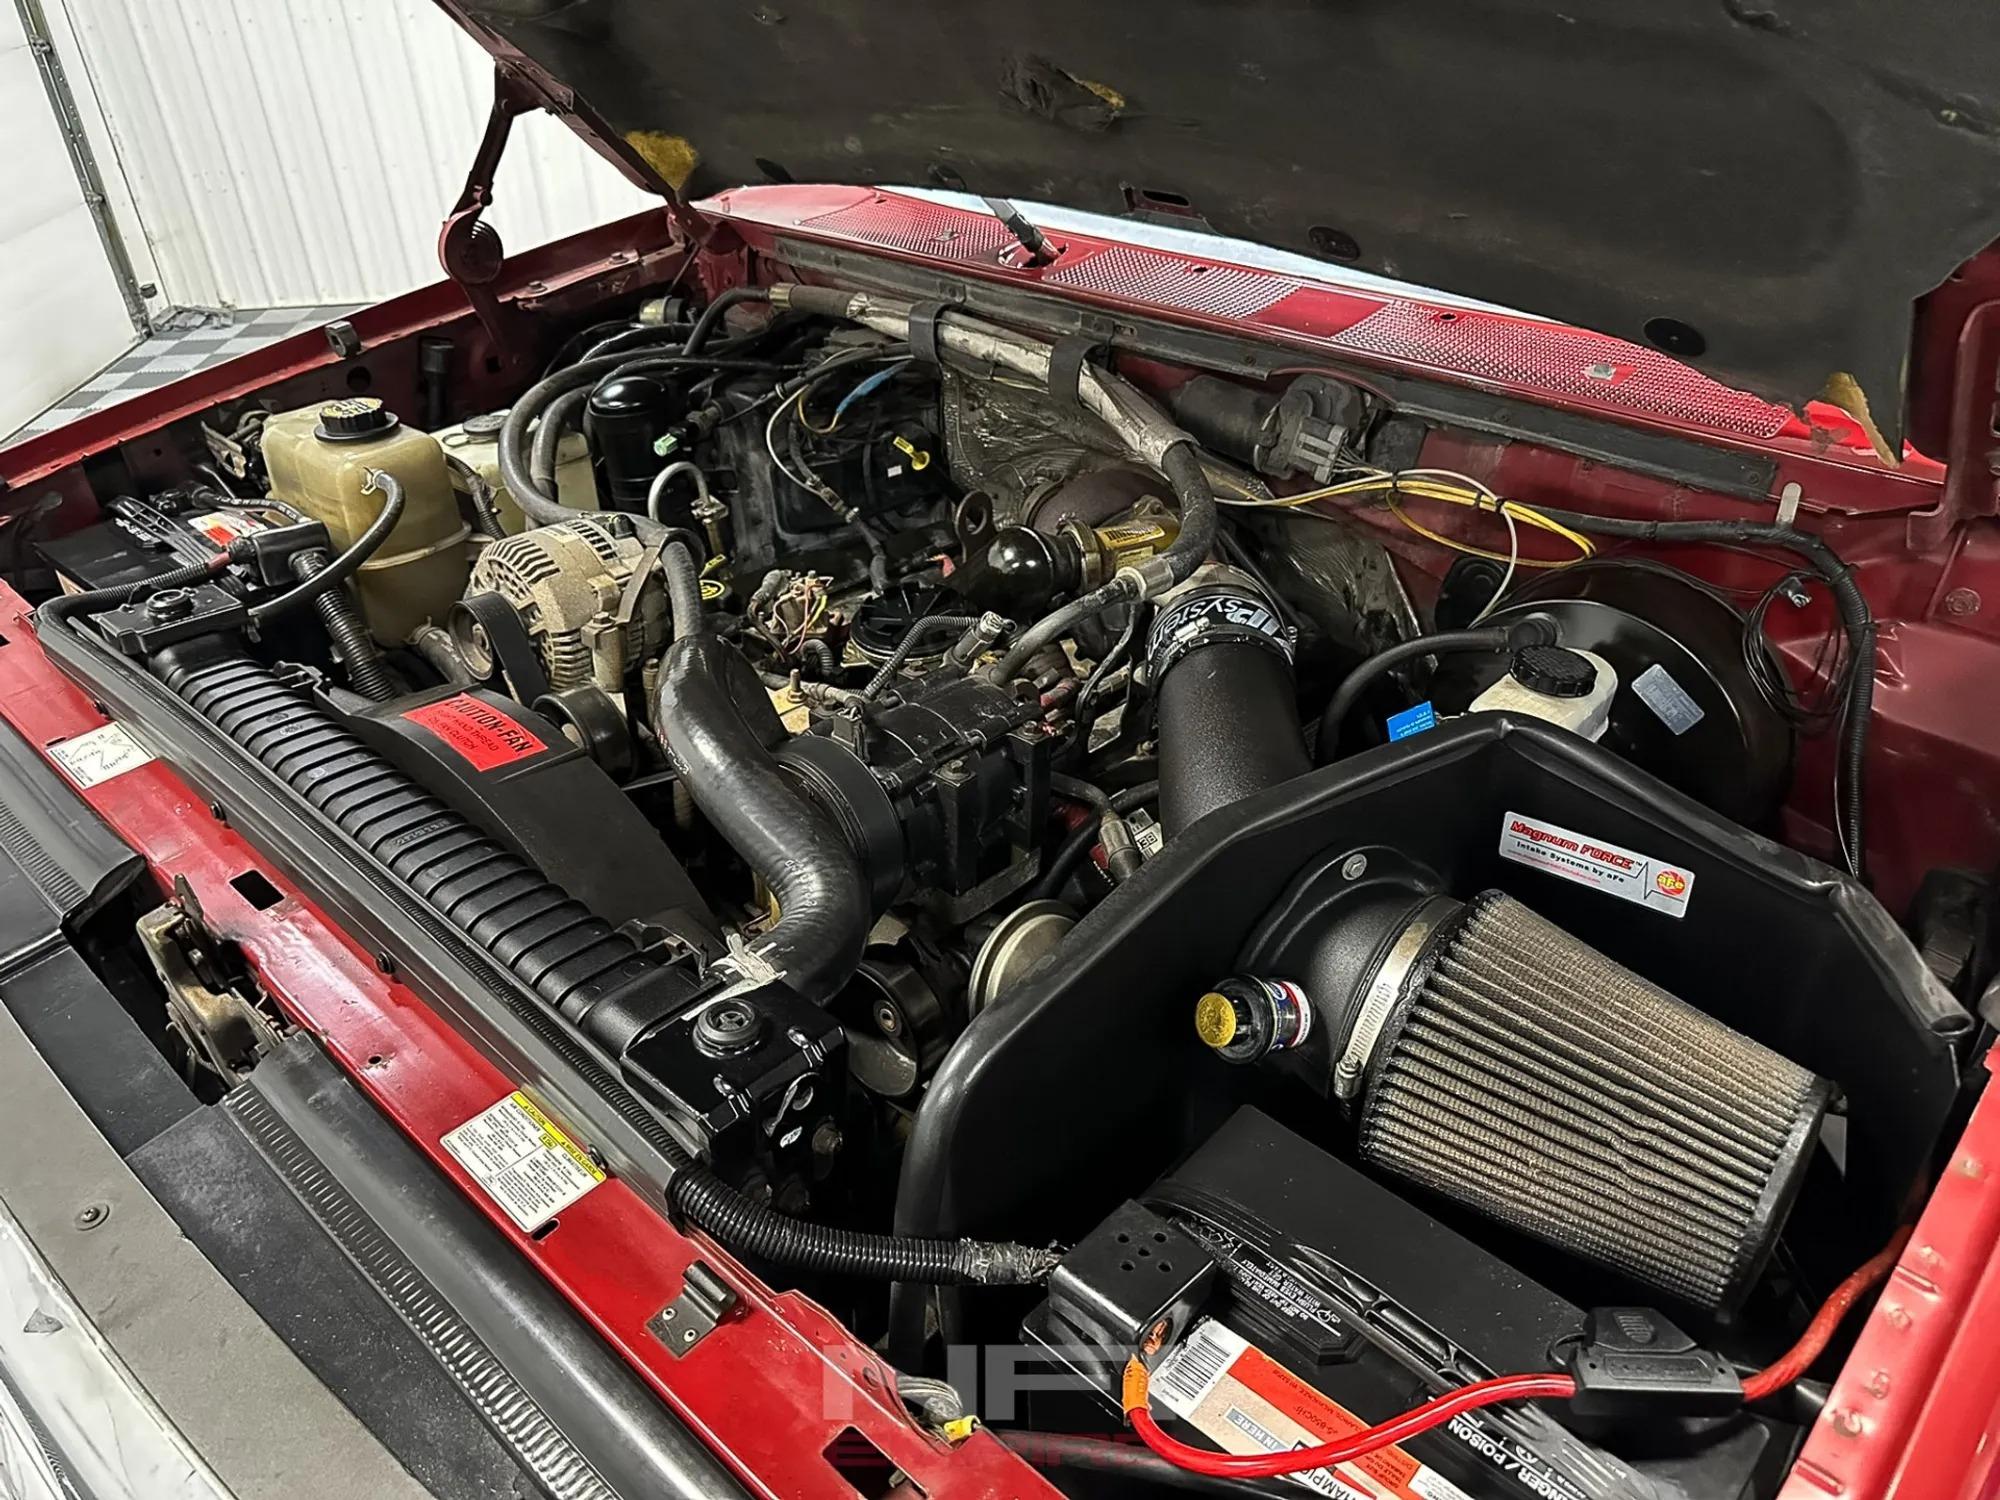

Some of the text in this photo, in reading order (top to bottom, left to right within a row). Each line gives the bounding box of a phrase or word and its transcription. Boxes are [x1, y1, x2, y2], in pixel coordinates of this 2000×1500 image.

[1510, 820, 1579, 852] Magnum
[1517, 841, 1625, 883] Intake Systems by aFe
[527, 1107, 546, 1125] CAUTION
[1240, 1257, 1280, 1289] IMMEDIATELY
[1268, 1268, 1282, 1281] GET
[1279, 1284, 1296, 1299] EYES
[1295, 1295, 1317, 1313] FLUSH
[1303, 1292, 1321, 1308] WITH
[1234, 1413, 1279, 1450] IN HERE
[1448, 1419, 1506, 1465] POISON
